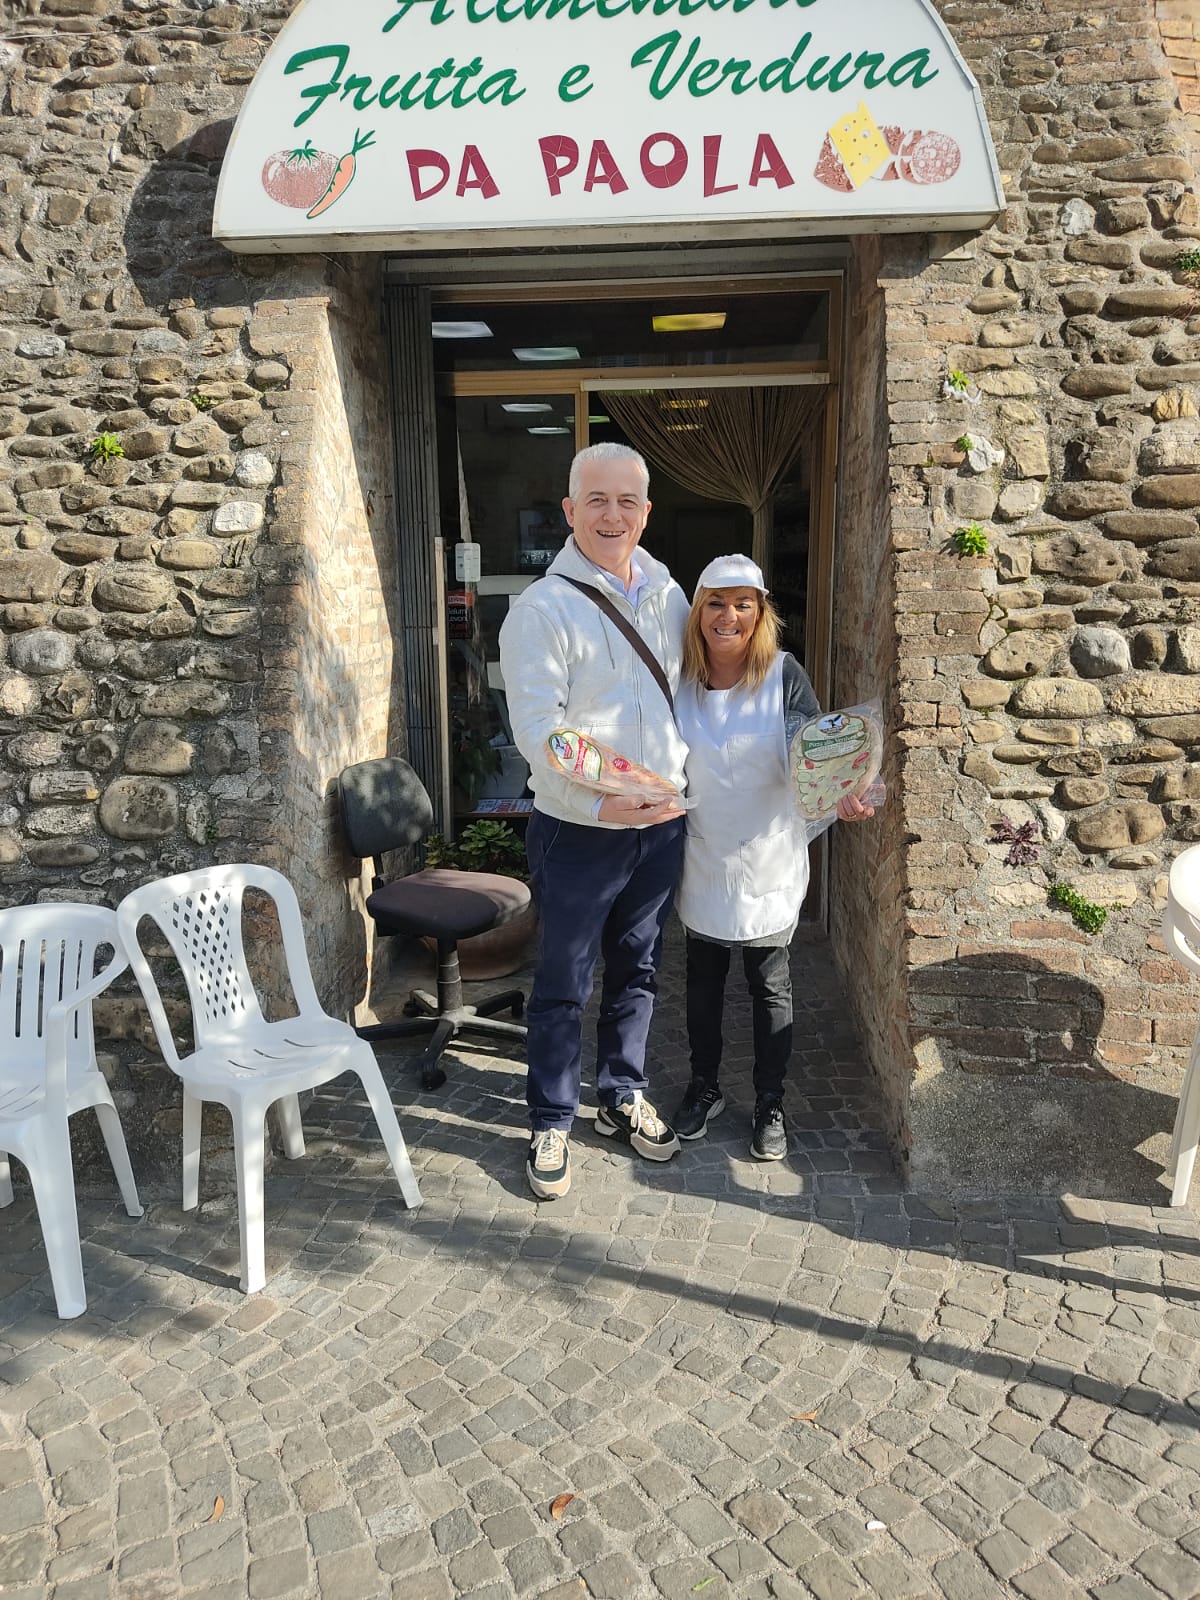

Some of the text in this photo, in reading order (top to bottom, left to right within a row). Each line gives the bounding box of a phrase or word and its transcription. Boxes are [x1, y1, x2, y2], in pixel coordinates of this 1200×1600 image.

[382, 0, 817, 33] Aimen
[284, 30, 938, 127] Frutta e Verdura
[407, 132, 795, 201] DA PAOLA
